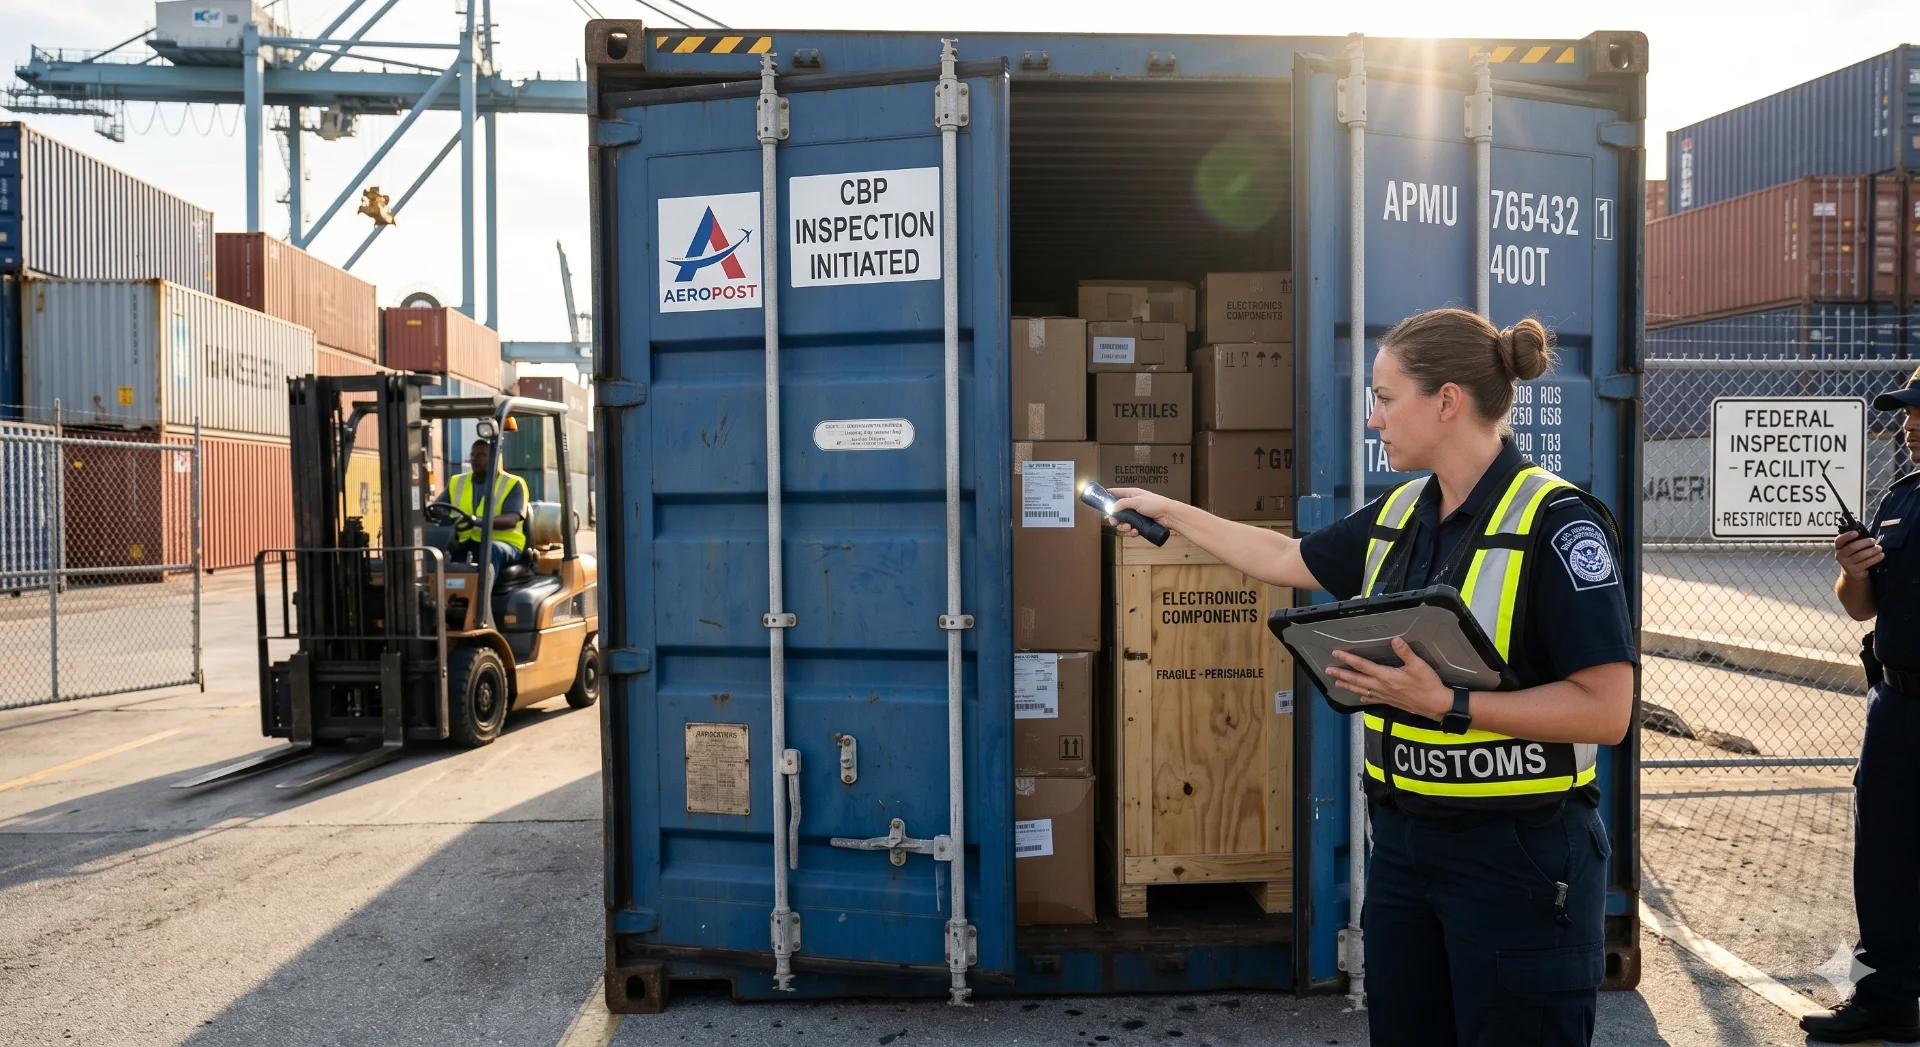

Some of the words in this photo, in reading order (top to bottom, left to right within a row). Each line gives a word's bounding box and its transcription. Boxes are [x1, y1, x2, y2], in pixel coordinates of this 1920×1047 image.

[840, 177, 888, 206] CBP
[1383, 180, 1459, 226] APMU
[1490, 189, 1580, 236] 765432
[1599, 201, 1608, 238] 1
[795, 211, 935, 245] INSPECTION
[810, 248, 920, 280] INITIATED
[1490, 244, 1550, 287] 400T
[663, 284, 758, 303] AEROPOST
[1227, 301, 1283, 310] ELECTRONICS
[1226, 311, 1283, 321] COMPONENTS
[1112, 403, 1178, 419] TEXTILES
[1745, 409, 1835, 428] FEDERAL
[1731, 434, 1847, 453] INSPECTION
[1115, 465, 1169, 475] ELECTRONICS
[1744, 459, 1832, 479] FACILITY
[1114, 475, 1169, 485] COMPONENTS
[1748, 484, 1828, 503] ACCESS
[1723, 511, 1802, 527] RESTRICTED
[1806, 511, 1855, 527] ACCE
[1162, 590, 1257, 606] ELECTRONICS
[1162, 608, 1258, 625] COMPONENTS
[1156, 669, 1197, 680] FRAGILE
[1204, 668, 1264, 679] PERISHABLE
[1394, 743, 1547, 779] CUSTOMS
